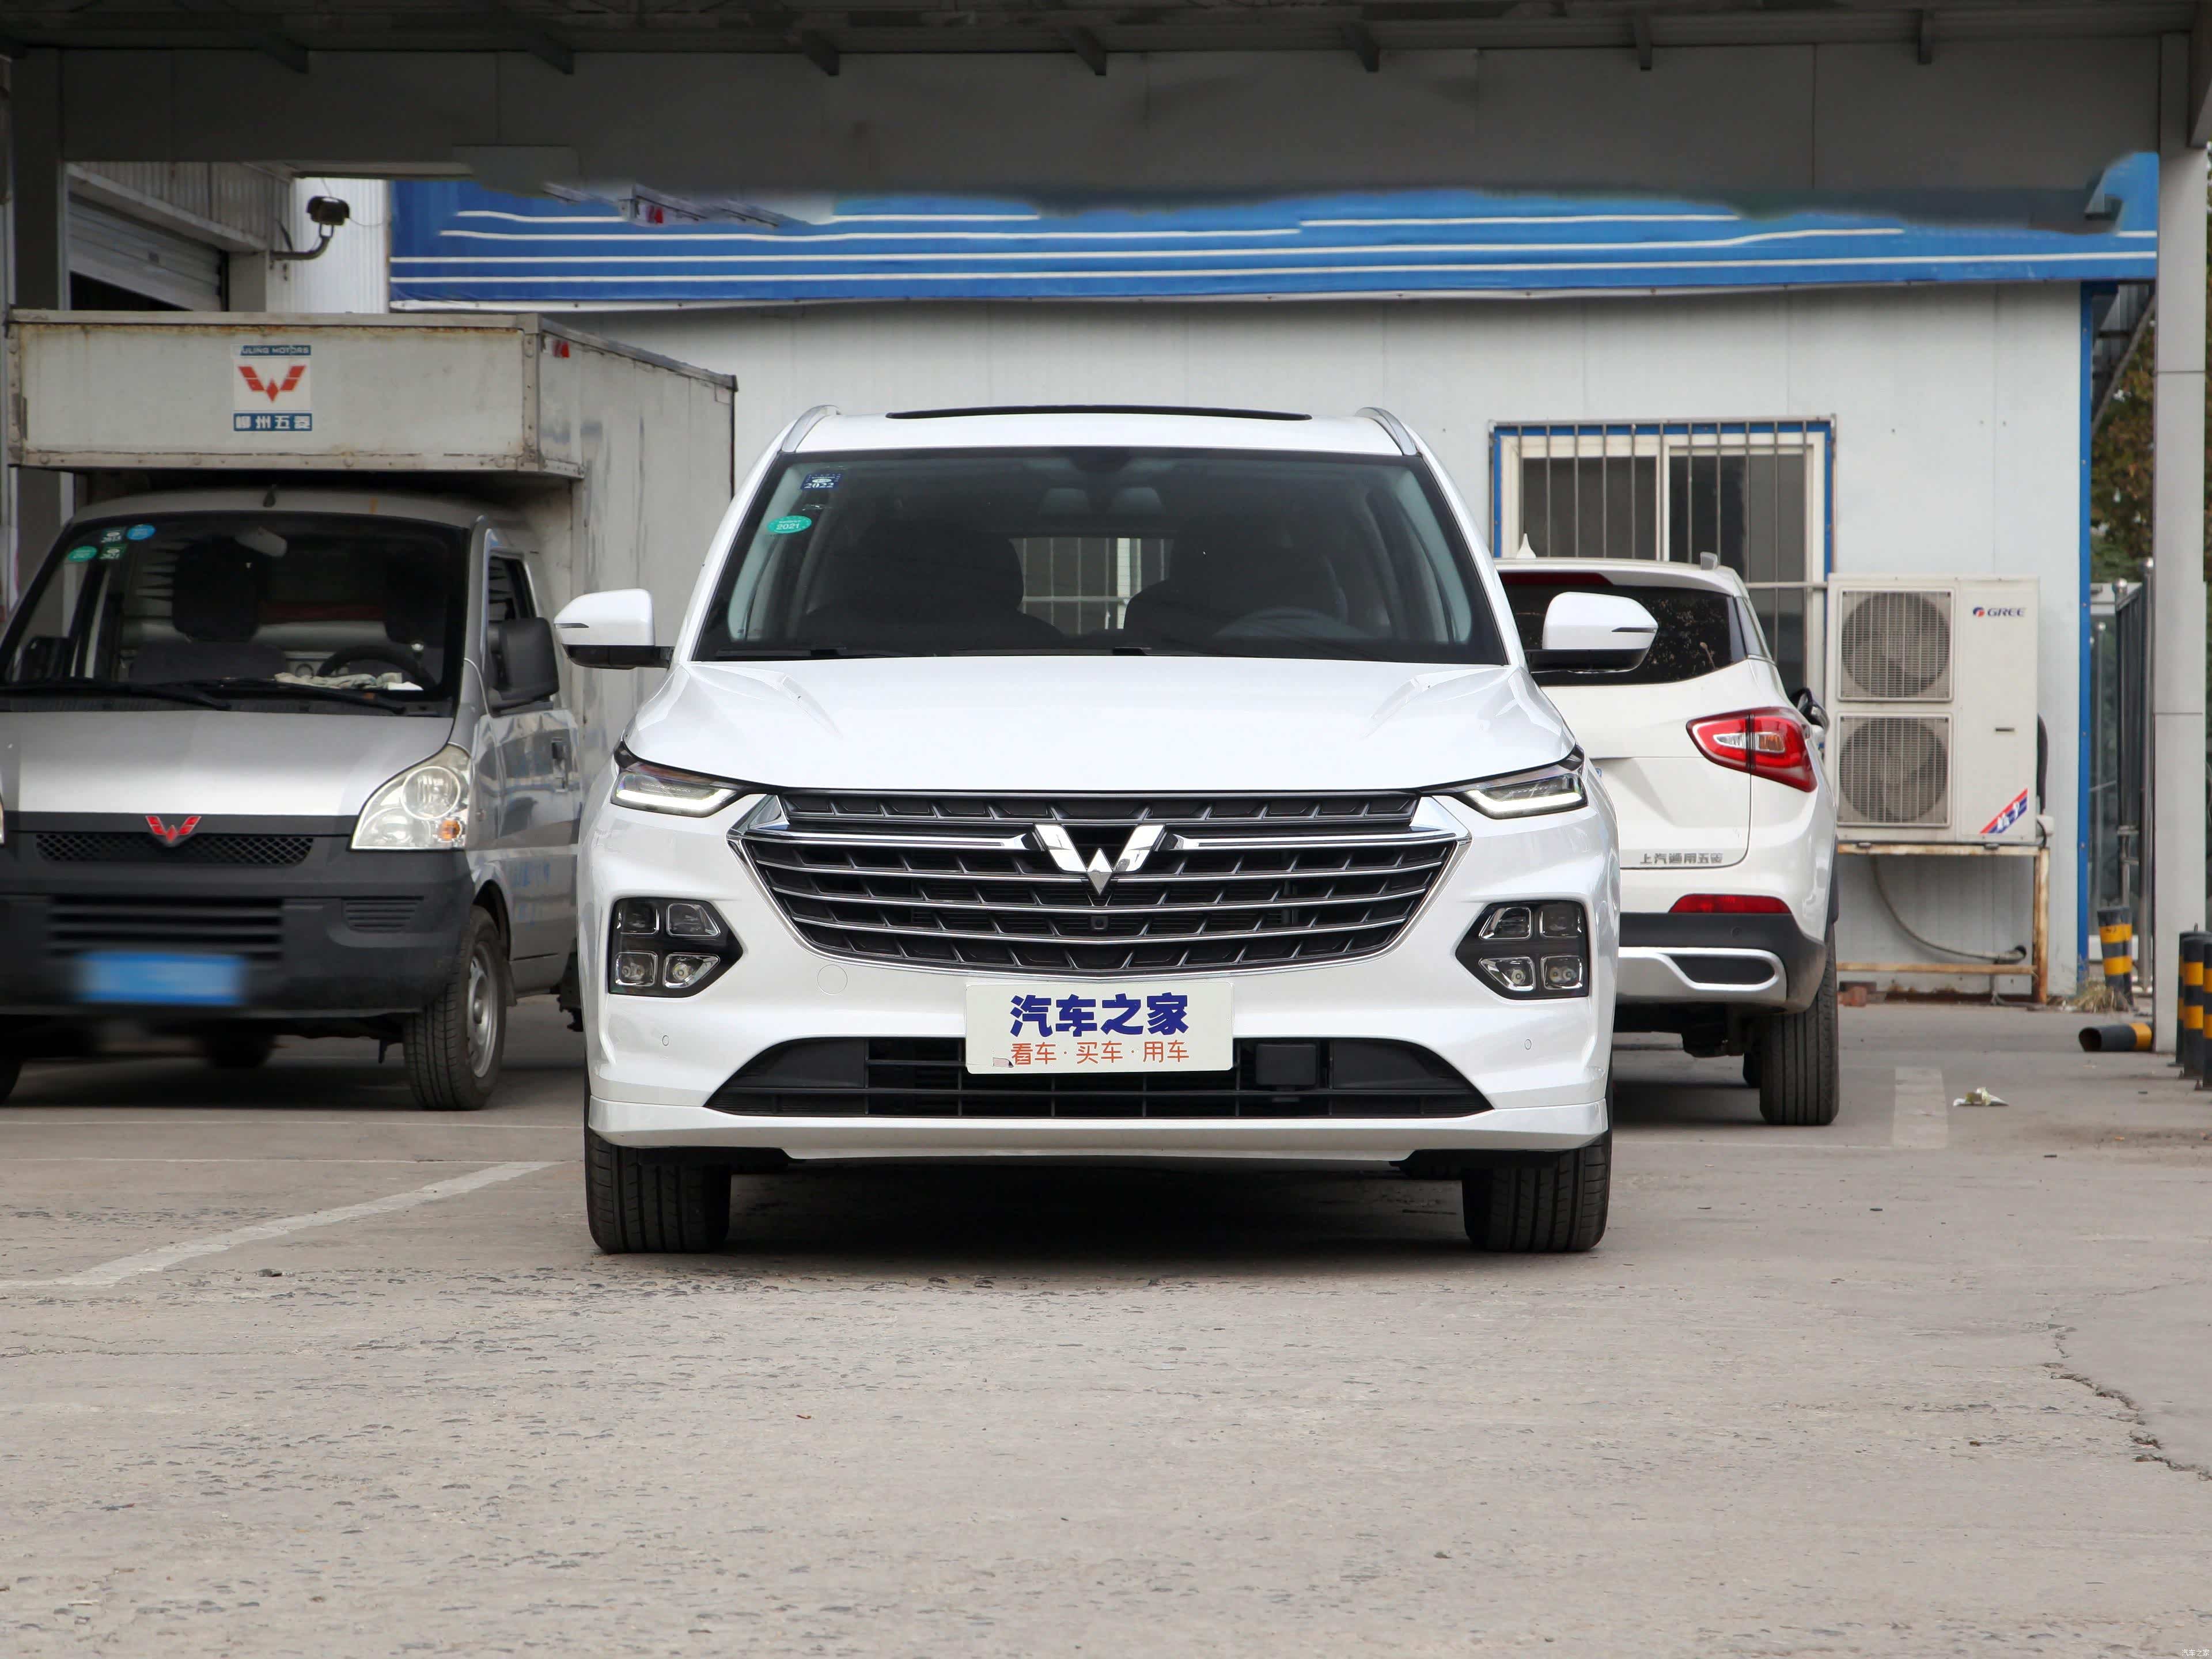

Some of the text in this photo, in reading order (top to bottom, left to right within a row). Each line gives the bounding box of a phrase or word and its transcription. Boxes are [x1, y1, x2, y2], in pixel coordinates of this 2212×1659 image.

[1987, 608, 2027, 616] GREE
[1009, 992, 1189, 1037] 汽车之家
[1010, 1039, 1190, 1065] 看车·买车·用车
